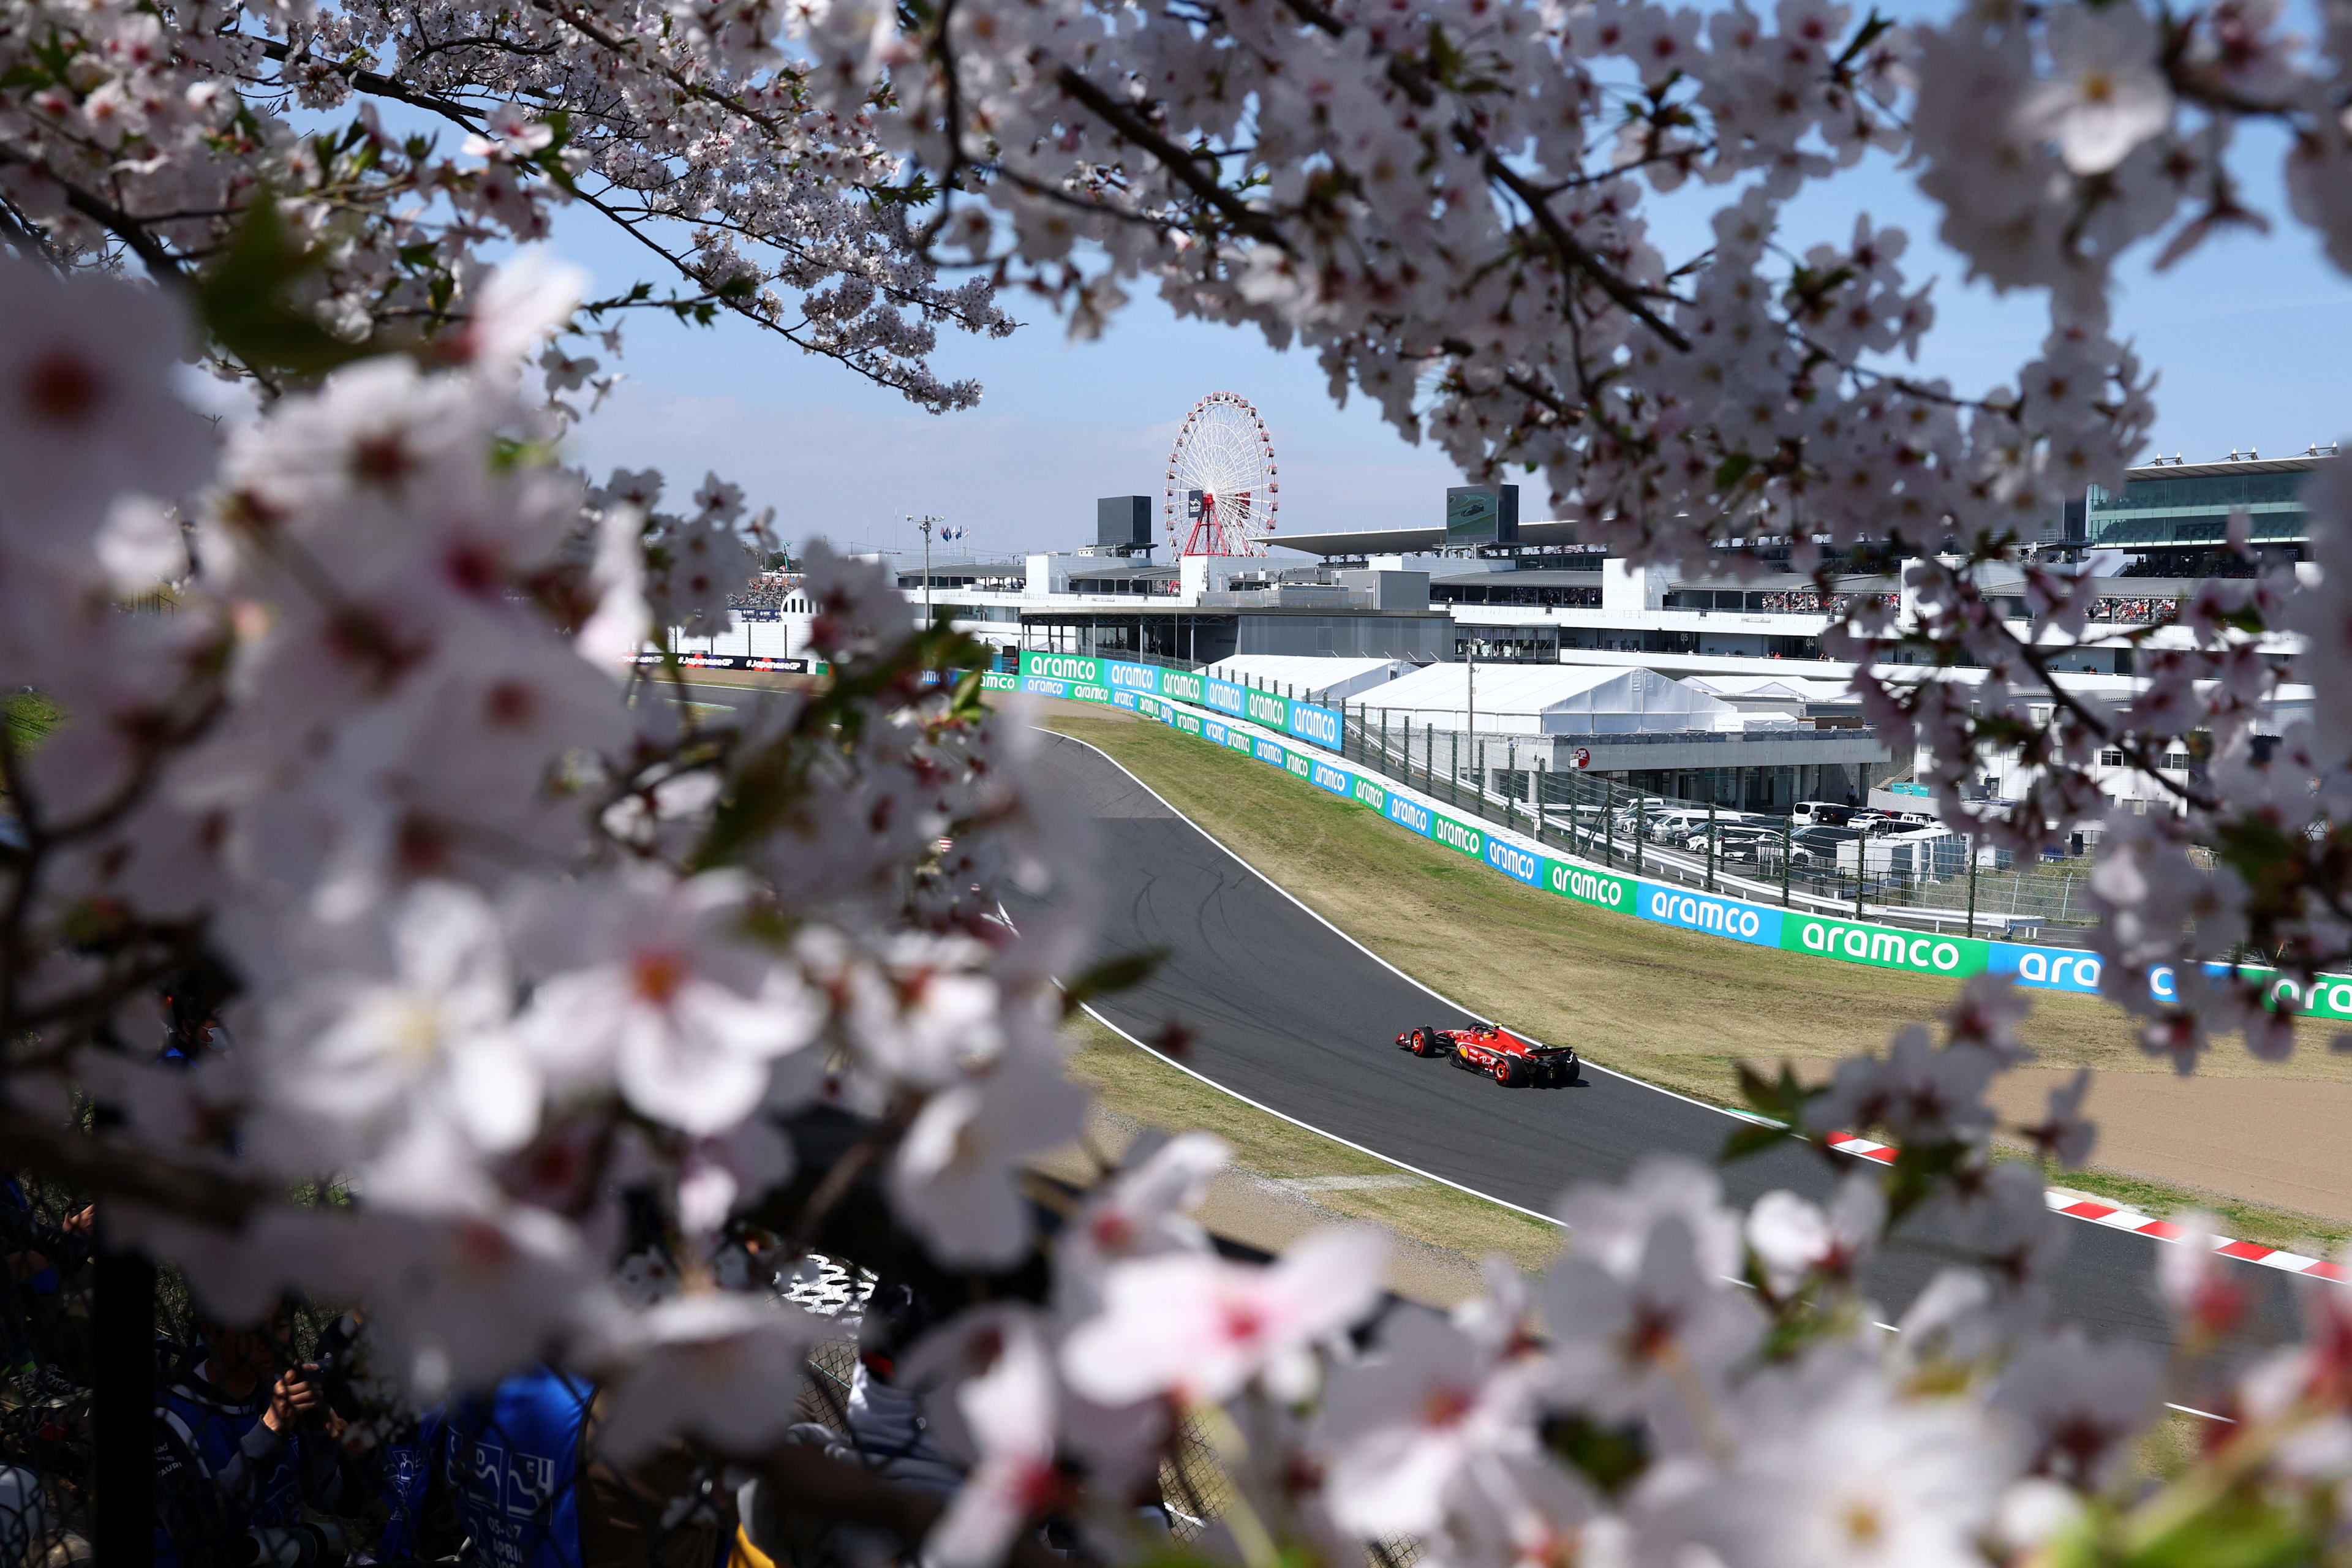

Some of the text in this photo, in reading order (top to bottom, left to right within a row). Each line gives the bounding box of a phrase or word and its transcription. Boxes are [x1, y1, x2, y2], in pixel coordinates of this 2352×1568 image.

[677, 656, 734, 666] #JapaneseGP
[746, 658, 801, 670] #JapaneseGP
[1031, 656, 1095, 680] aramco
[980, 676, 1016, 689] amco
[1028, 679, 1063, 695] aramco
[1112, 665, 1153, 690] aramco
[1164, 672, 1199, 699] aramco
[1074, 686, 1108, 701] aramco
[1210, 683, 1240, 712] aramco
[1250, 693, 1283, 726] aramco
[1295, 707, 1335, 742] aramco
[1257, 741, 1282, 764] aramco
[1316, 765, 1345, 791] aramco
[1392, 796, 1427, 832] aramco
[1437, 818, 1479, 854] aramco
[1489, 842, 1534, 880] aramco
[1552, 865, 1622, 906] aramco
[1652, 891, 1759, 937] aramco
[1802, 922, 1959, 970] aramco
